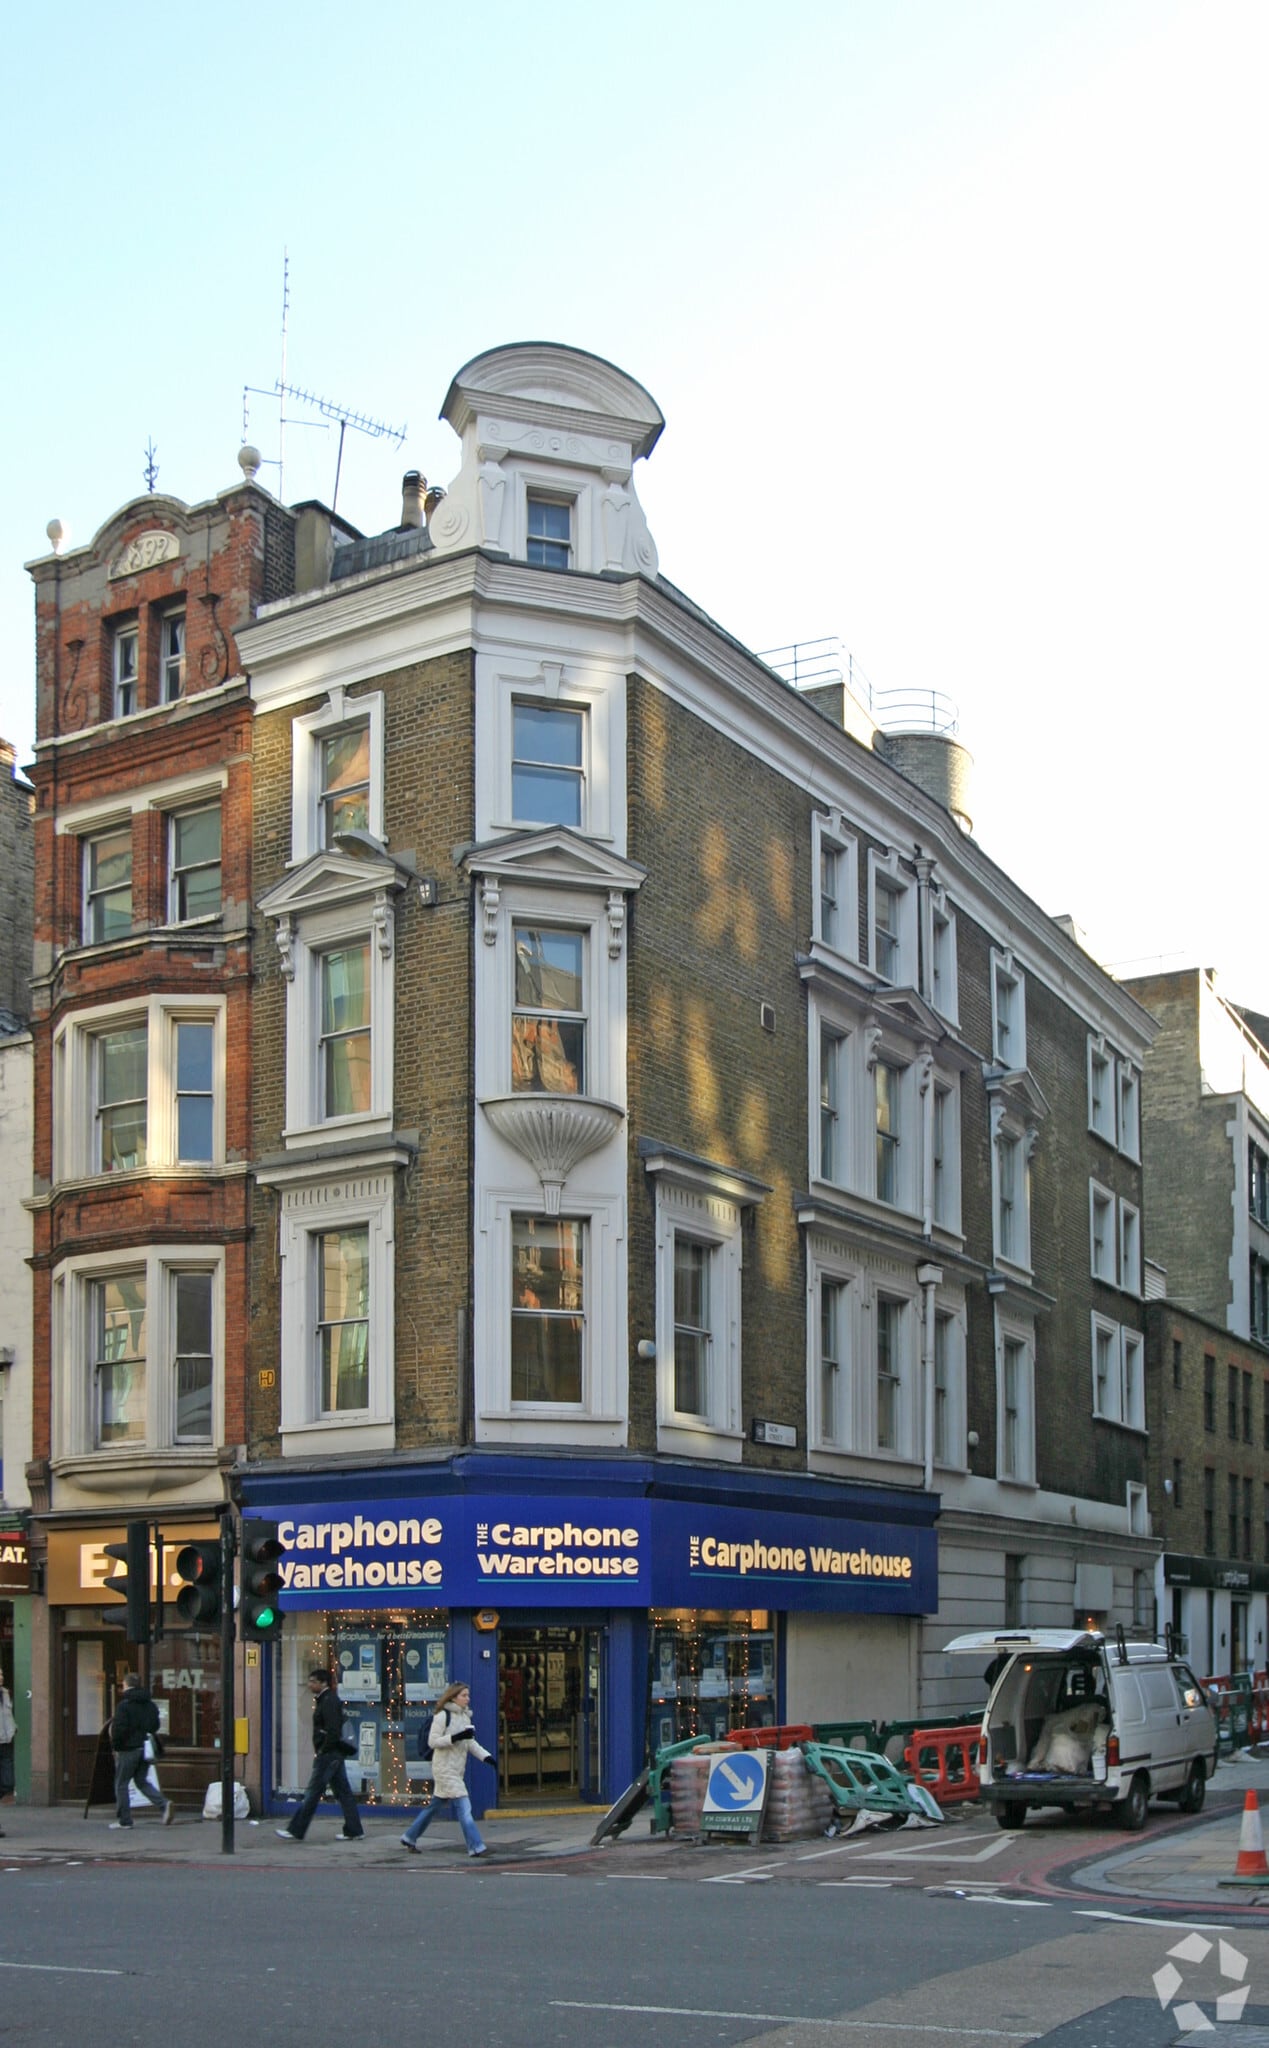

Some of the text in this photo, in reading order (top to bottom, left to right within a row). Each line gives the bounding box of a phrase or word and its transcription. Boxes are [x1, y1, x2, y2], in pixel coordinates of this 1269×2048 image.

[278, 1515, 443, 1555] Carphone
[476, 1523, 640, 1551] THE Carphone
[0, 1546, 28, 1564] AT.
[477, 1552, 640, 1575] Warehouse
[689, 1535, 912, 1579] THE Carphone Warehouse
[162, 1669, 207, 1689] EAT.
